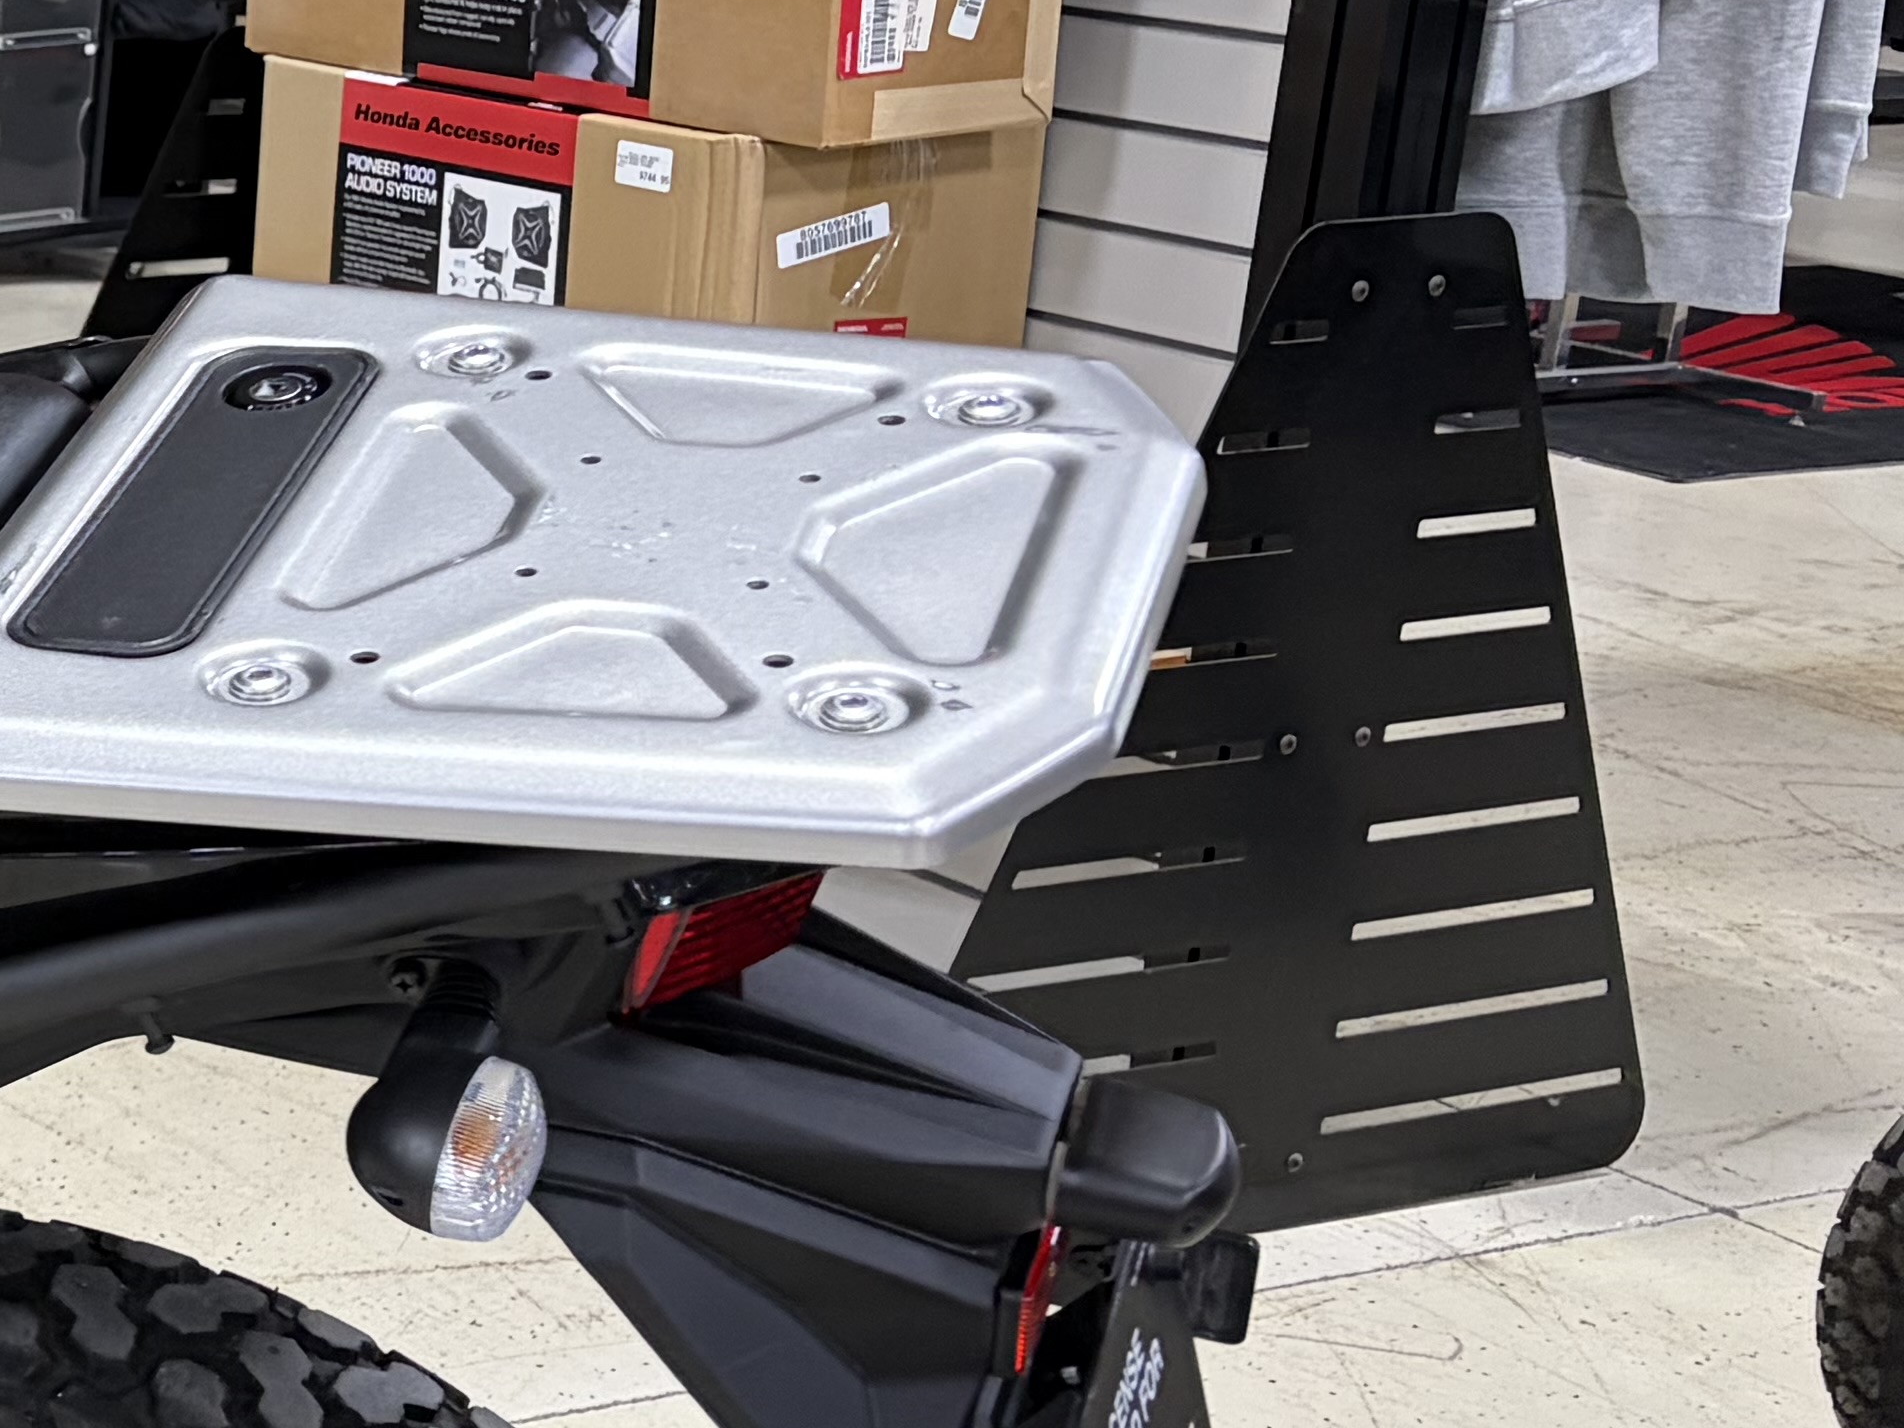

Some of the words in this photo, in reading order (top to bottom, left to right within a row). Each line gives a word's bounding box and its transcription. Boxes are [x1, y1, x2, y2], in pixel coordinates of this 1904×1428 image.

[354, 103, 421, 131] Honda
[425, 116, 561, 156] Accessories
[344, 173, 384, 195] AUDIO
[386, 181, 437, 205] SYSTEM
[347, 152, 401, 180] PIONEER
[403, 163, 437, 186] 1000
[1138, 1337, 1165, 1415] FOR
